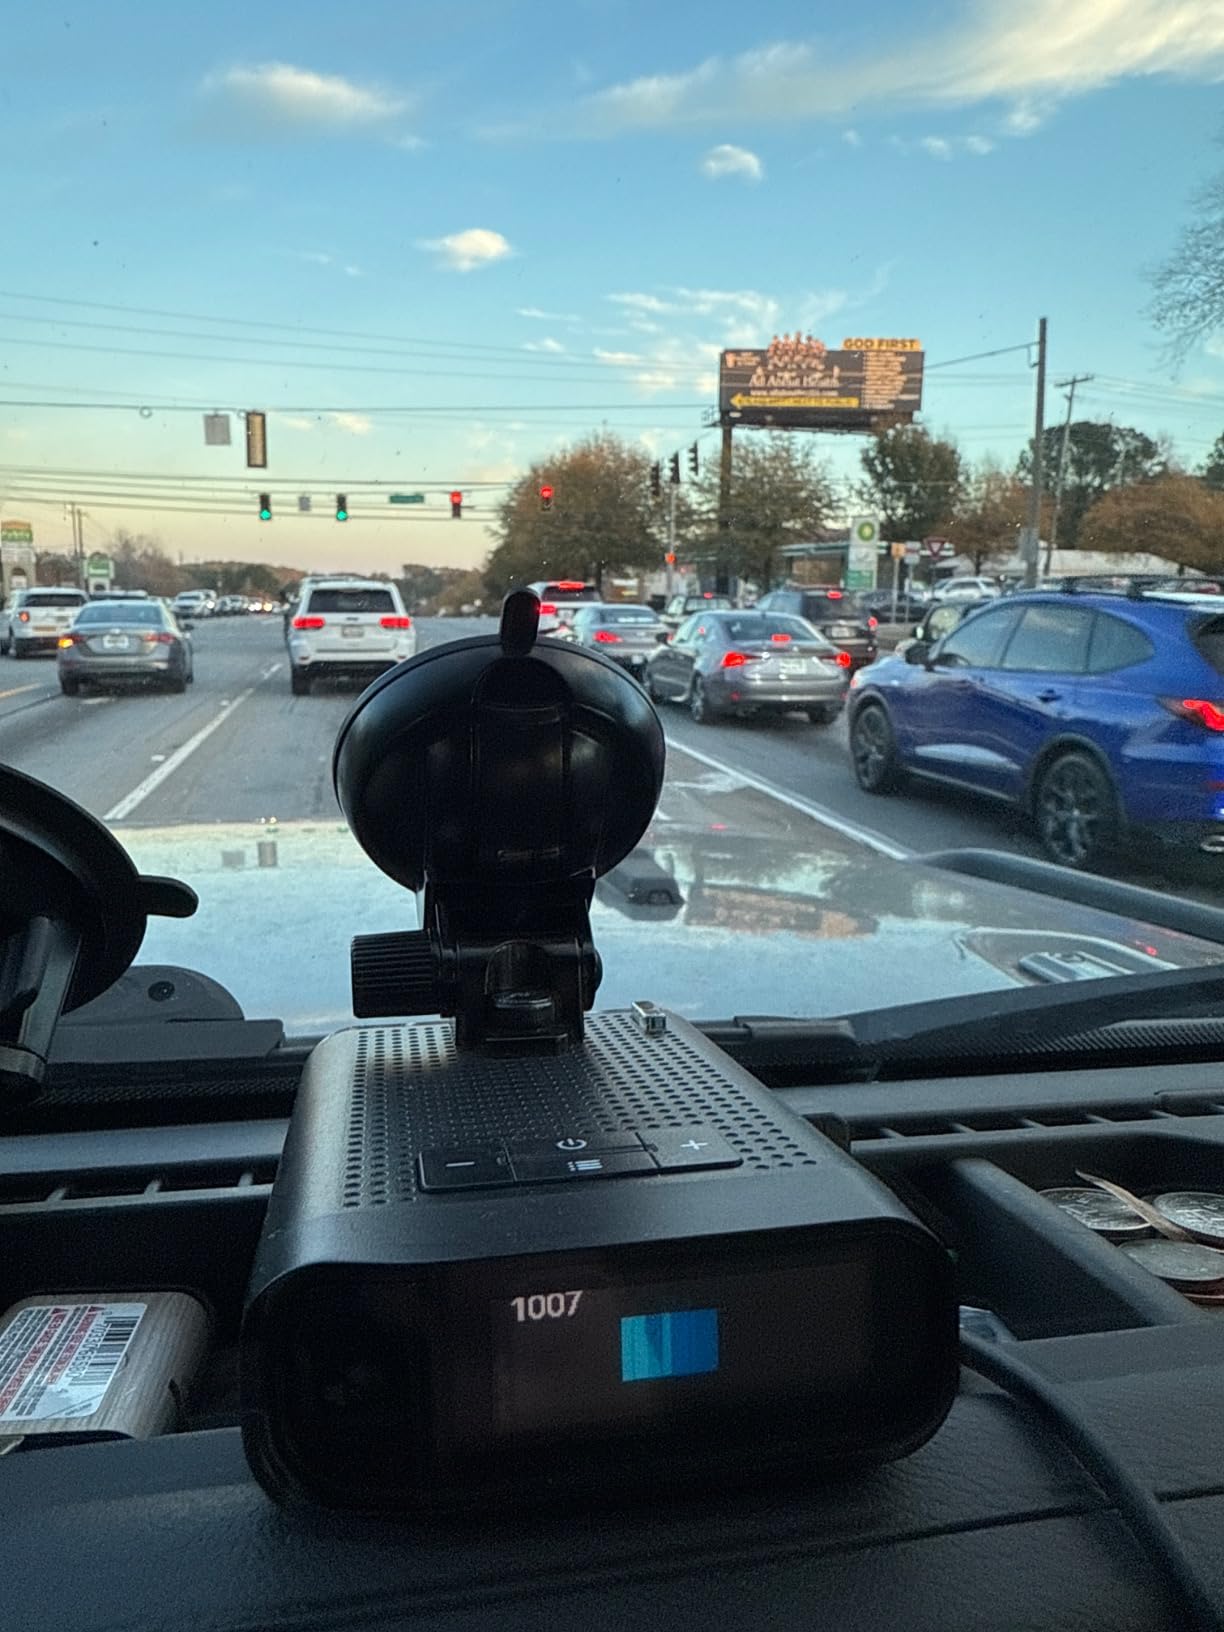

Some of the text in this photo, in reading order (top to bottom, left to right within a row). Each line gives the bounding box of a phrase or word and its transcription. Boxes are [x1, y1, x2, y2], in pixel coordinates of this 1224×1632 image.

[844, 339, 916, 349] GOD FIRST
[511, 1290, 583, 1322] 1007
